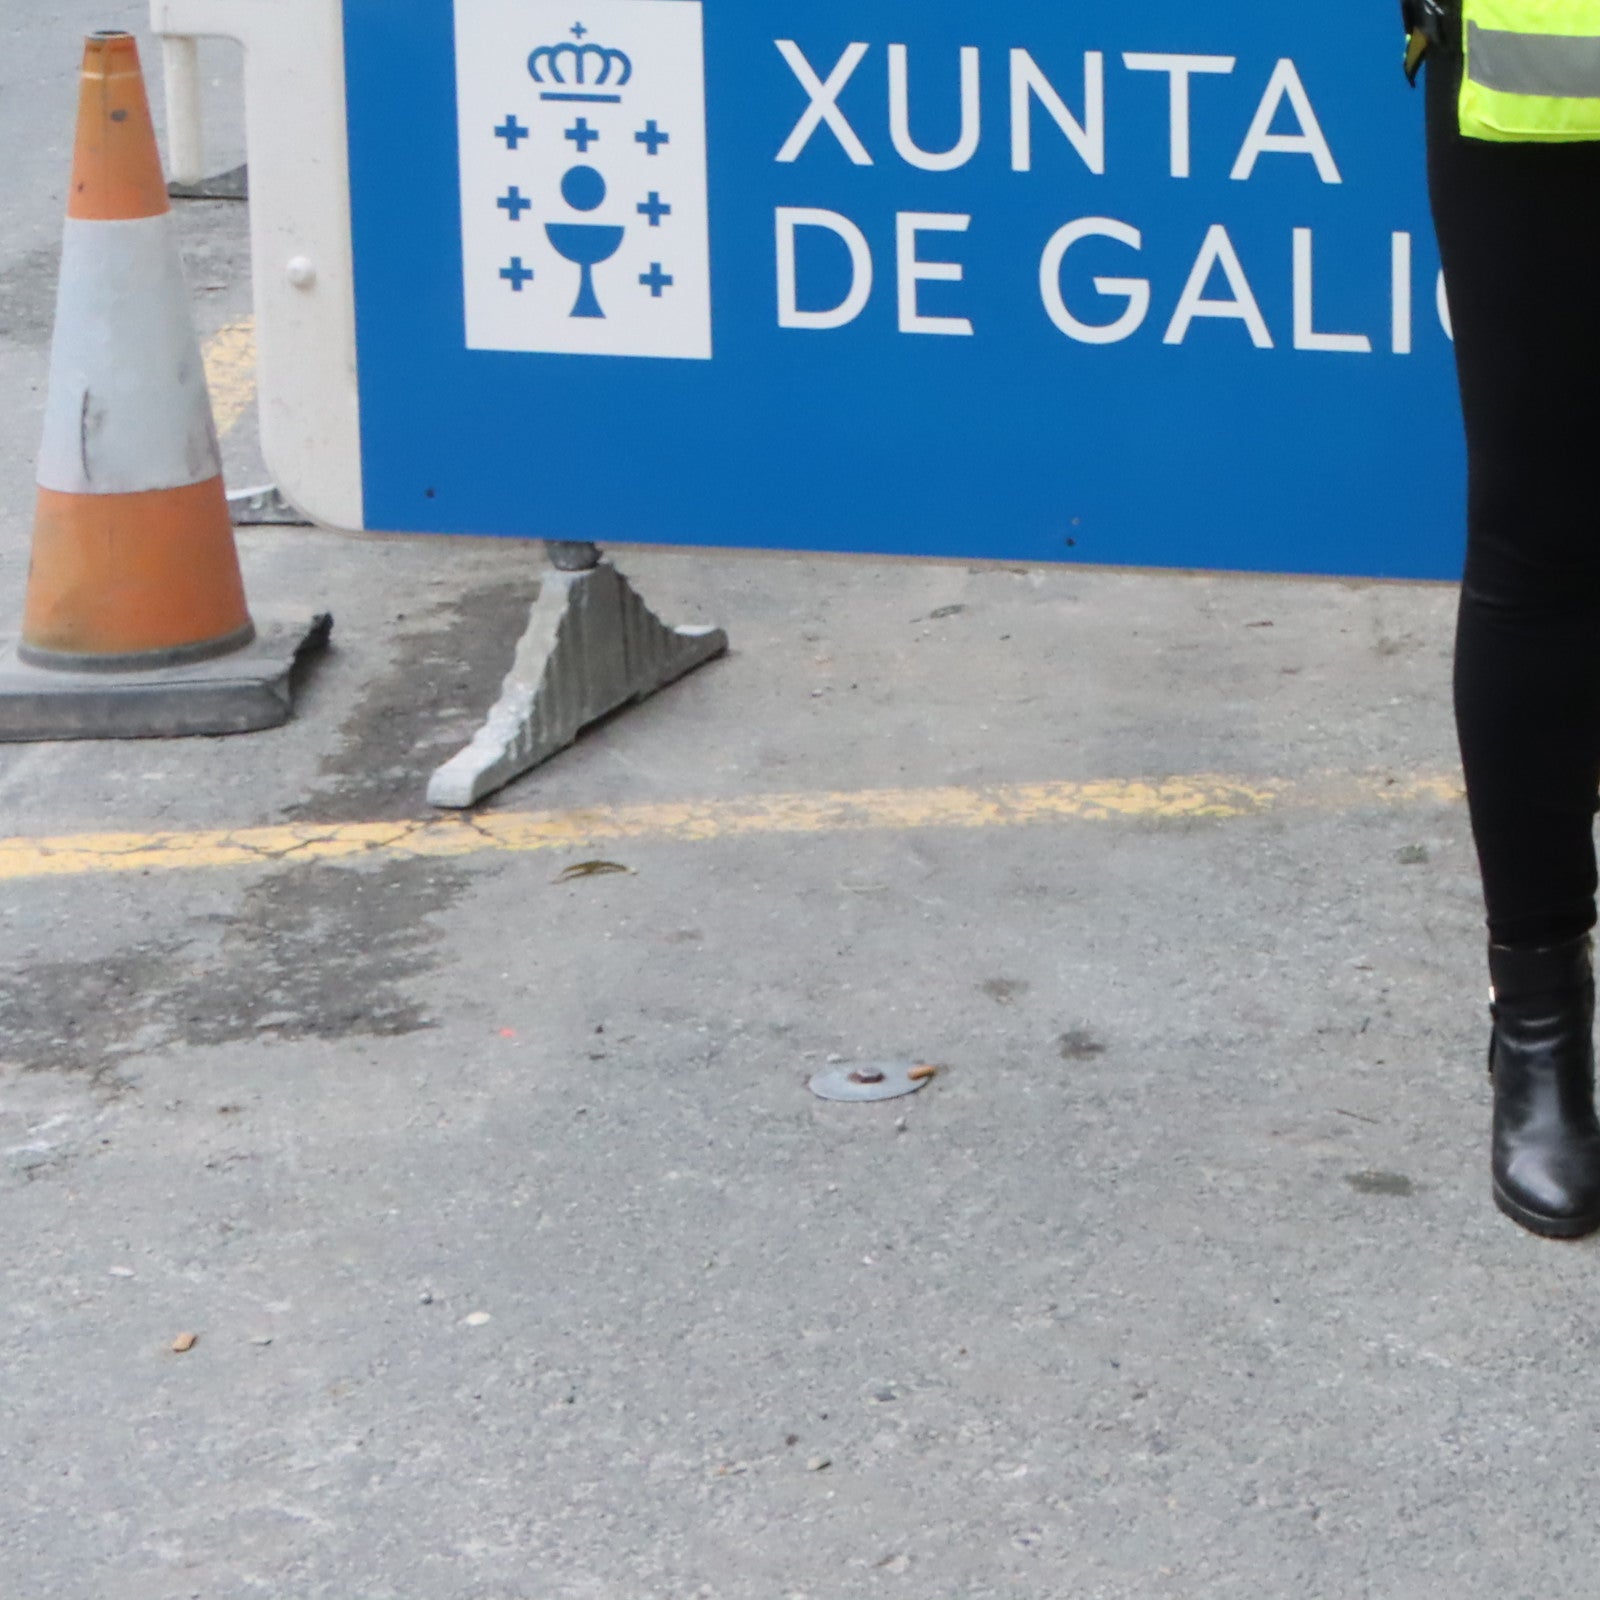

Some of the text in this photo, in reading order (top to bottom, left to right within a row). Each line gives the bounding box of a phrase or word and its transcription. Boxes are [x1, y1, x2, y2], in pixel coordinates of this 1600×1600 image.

[772, 40, 1342, 185] XUNTA
[774, 206, 1460, 355] DE GALI
